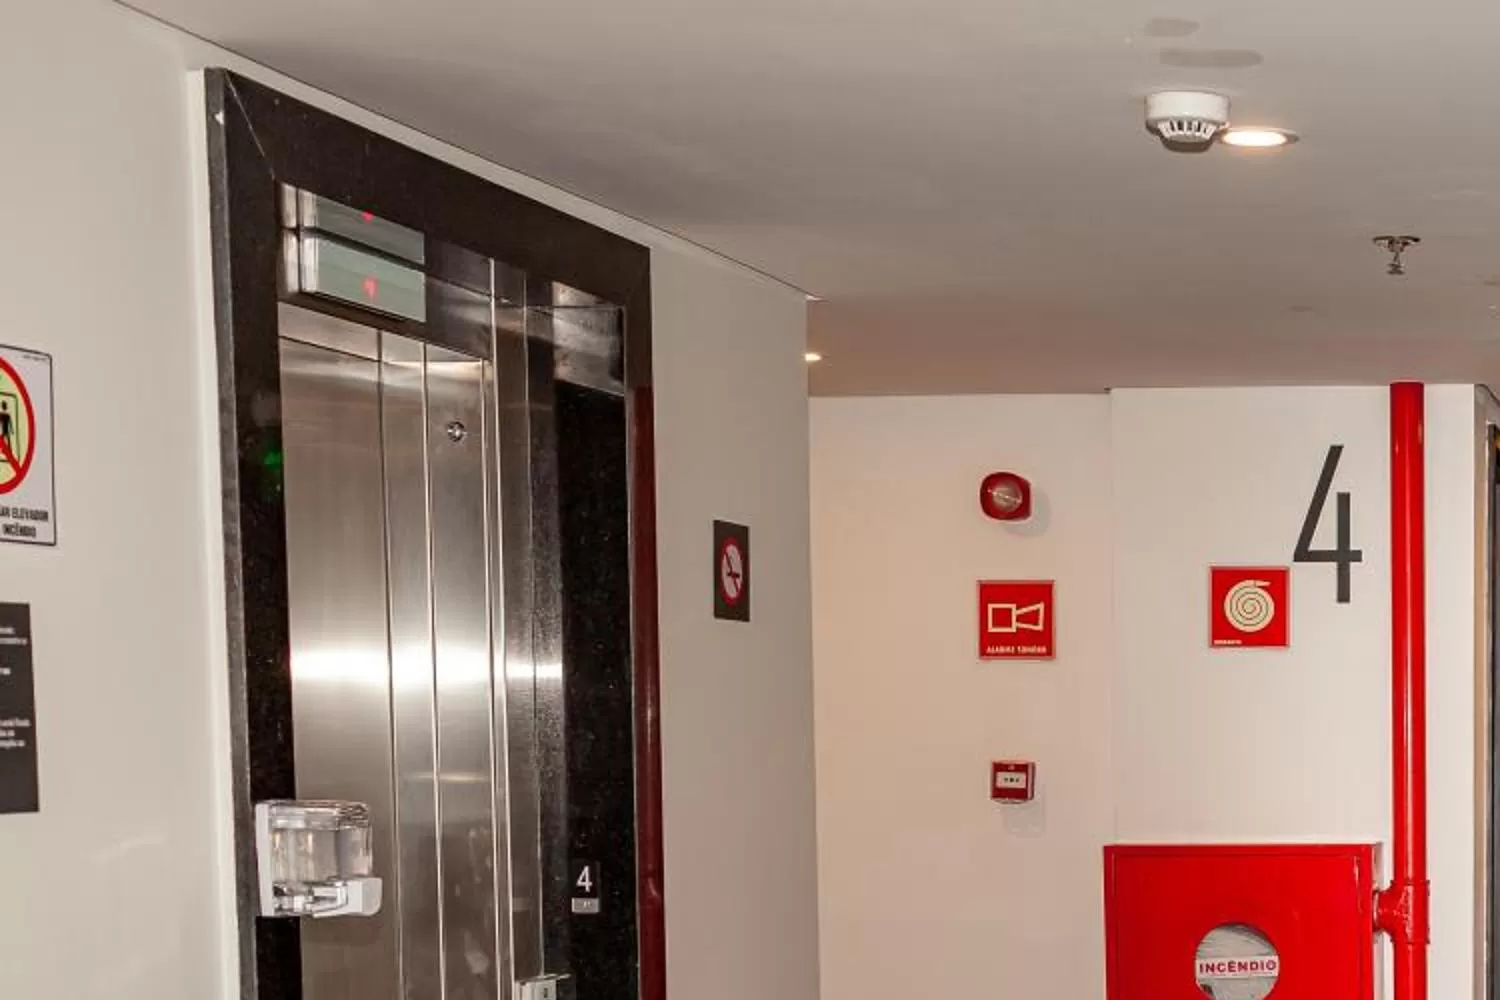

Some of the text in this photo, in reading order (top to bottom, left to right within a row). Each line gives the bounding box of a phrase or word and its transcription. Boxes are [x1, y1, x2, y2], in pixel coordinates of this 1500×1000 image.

[1293, 444, 1363, 603] 4
[576, 865, 593, 893] 4
[1199, 959, 1277, 974] INCÊNDIO
